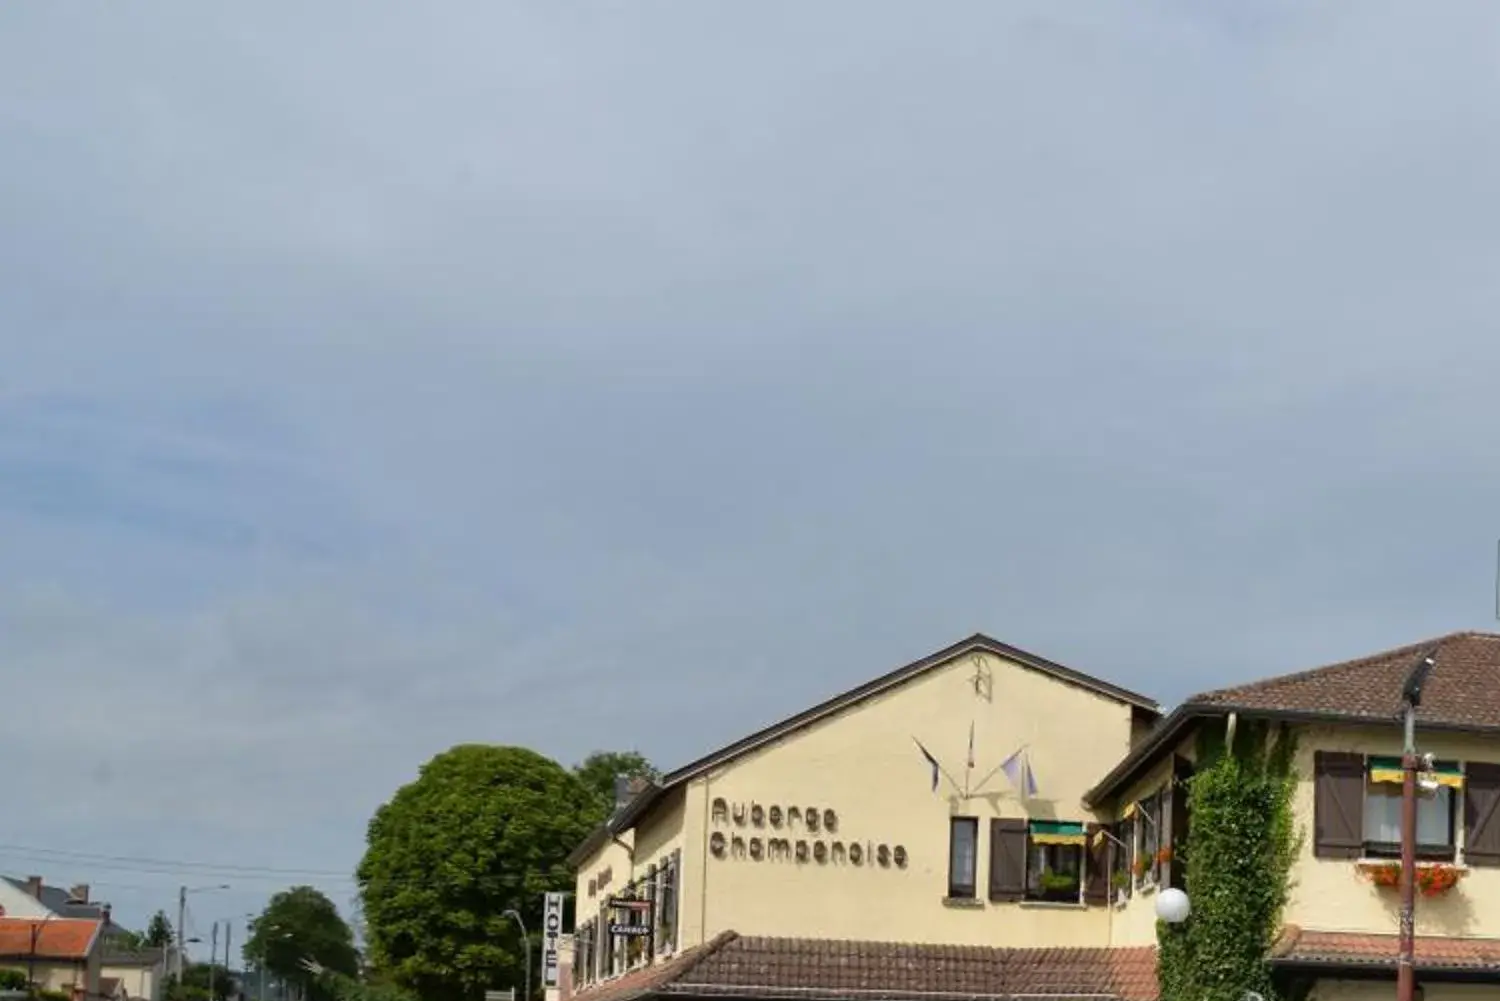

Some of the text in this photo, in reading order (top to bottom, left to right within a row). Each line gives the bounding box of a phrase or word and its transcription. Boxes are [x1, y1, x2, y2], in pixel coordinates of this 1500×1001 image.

[712, 797, 837, 834] Auberge
[710, 831, 908, 869] Champenoise
[544, 895, 561, 986] HOTEL
